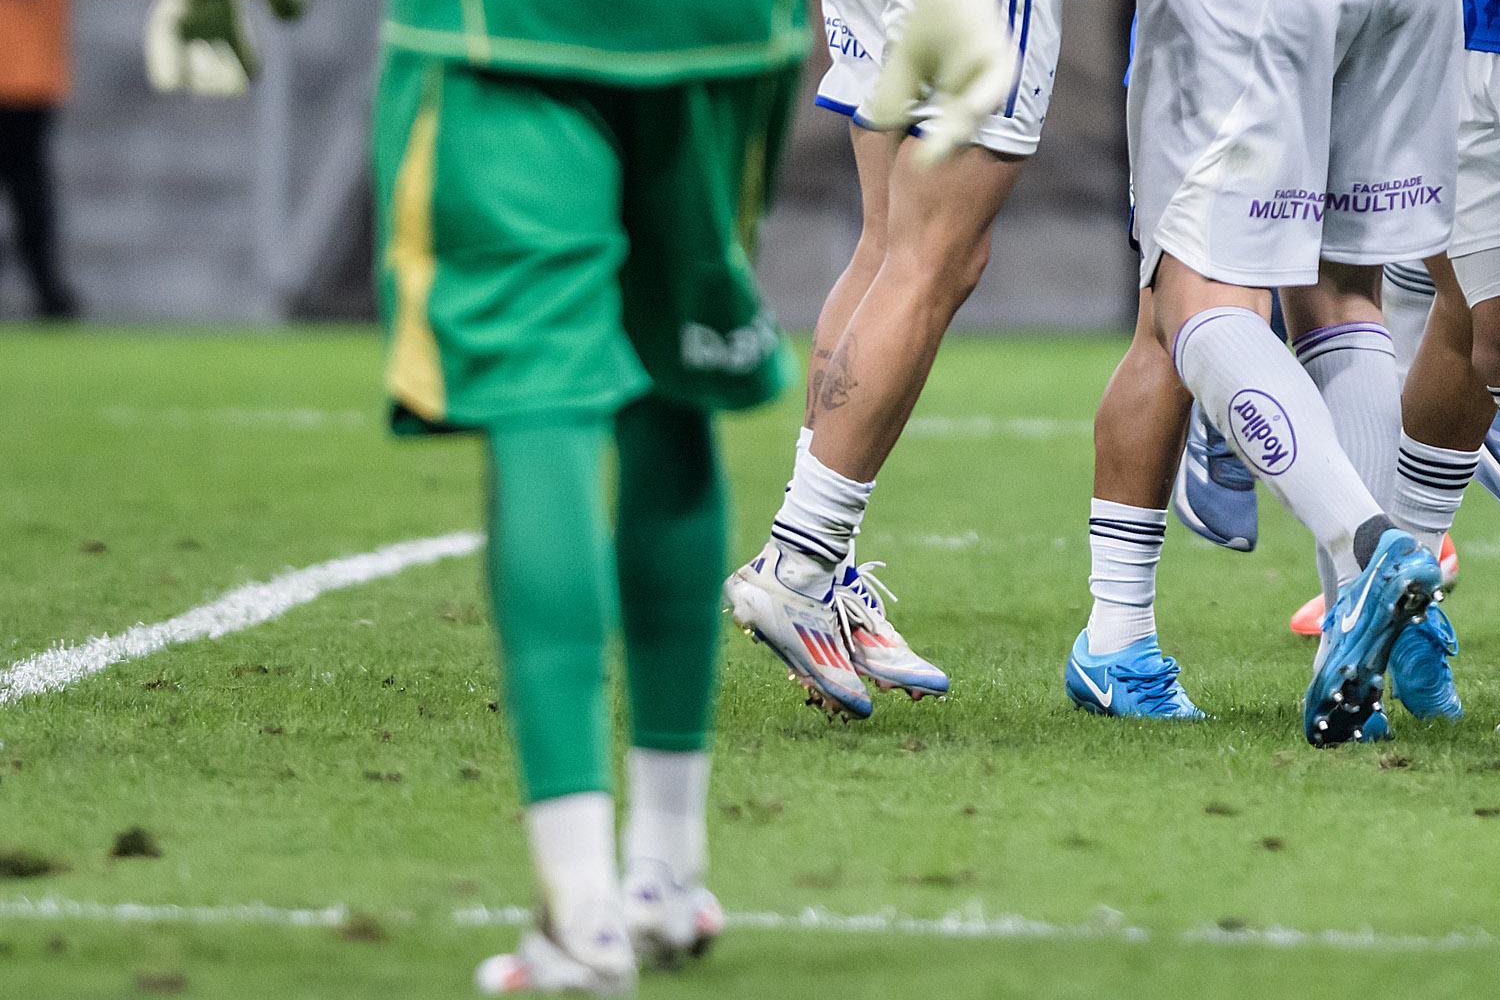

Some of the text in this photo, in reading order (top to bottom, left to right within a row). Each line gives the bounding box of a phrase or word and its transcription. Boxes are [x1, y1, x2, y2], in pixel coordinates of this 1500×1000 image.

[1353, 175, 1424, 194] FACULDADE
[1325, 186, 1444, 214] MULTIVIX
[1233, 399, 1289, 468] Kodilar
